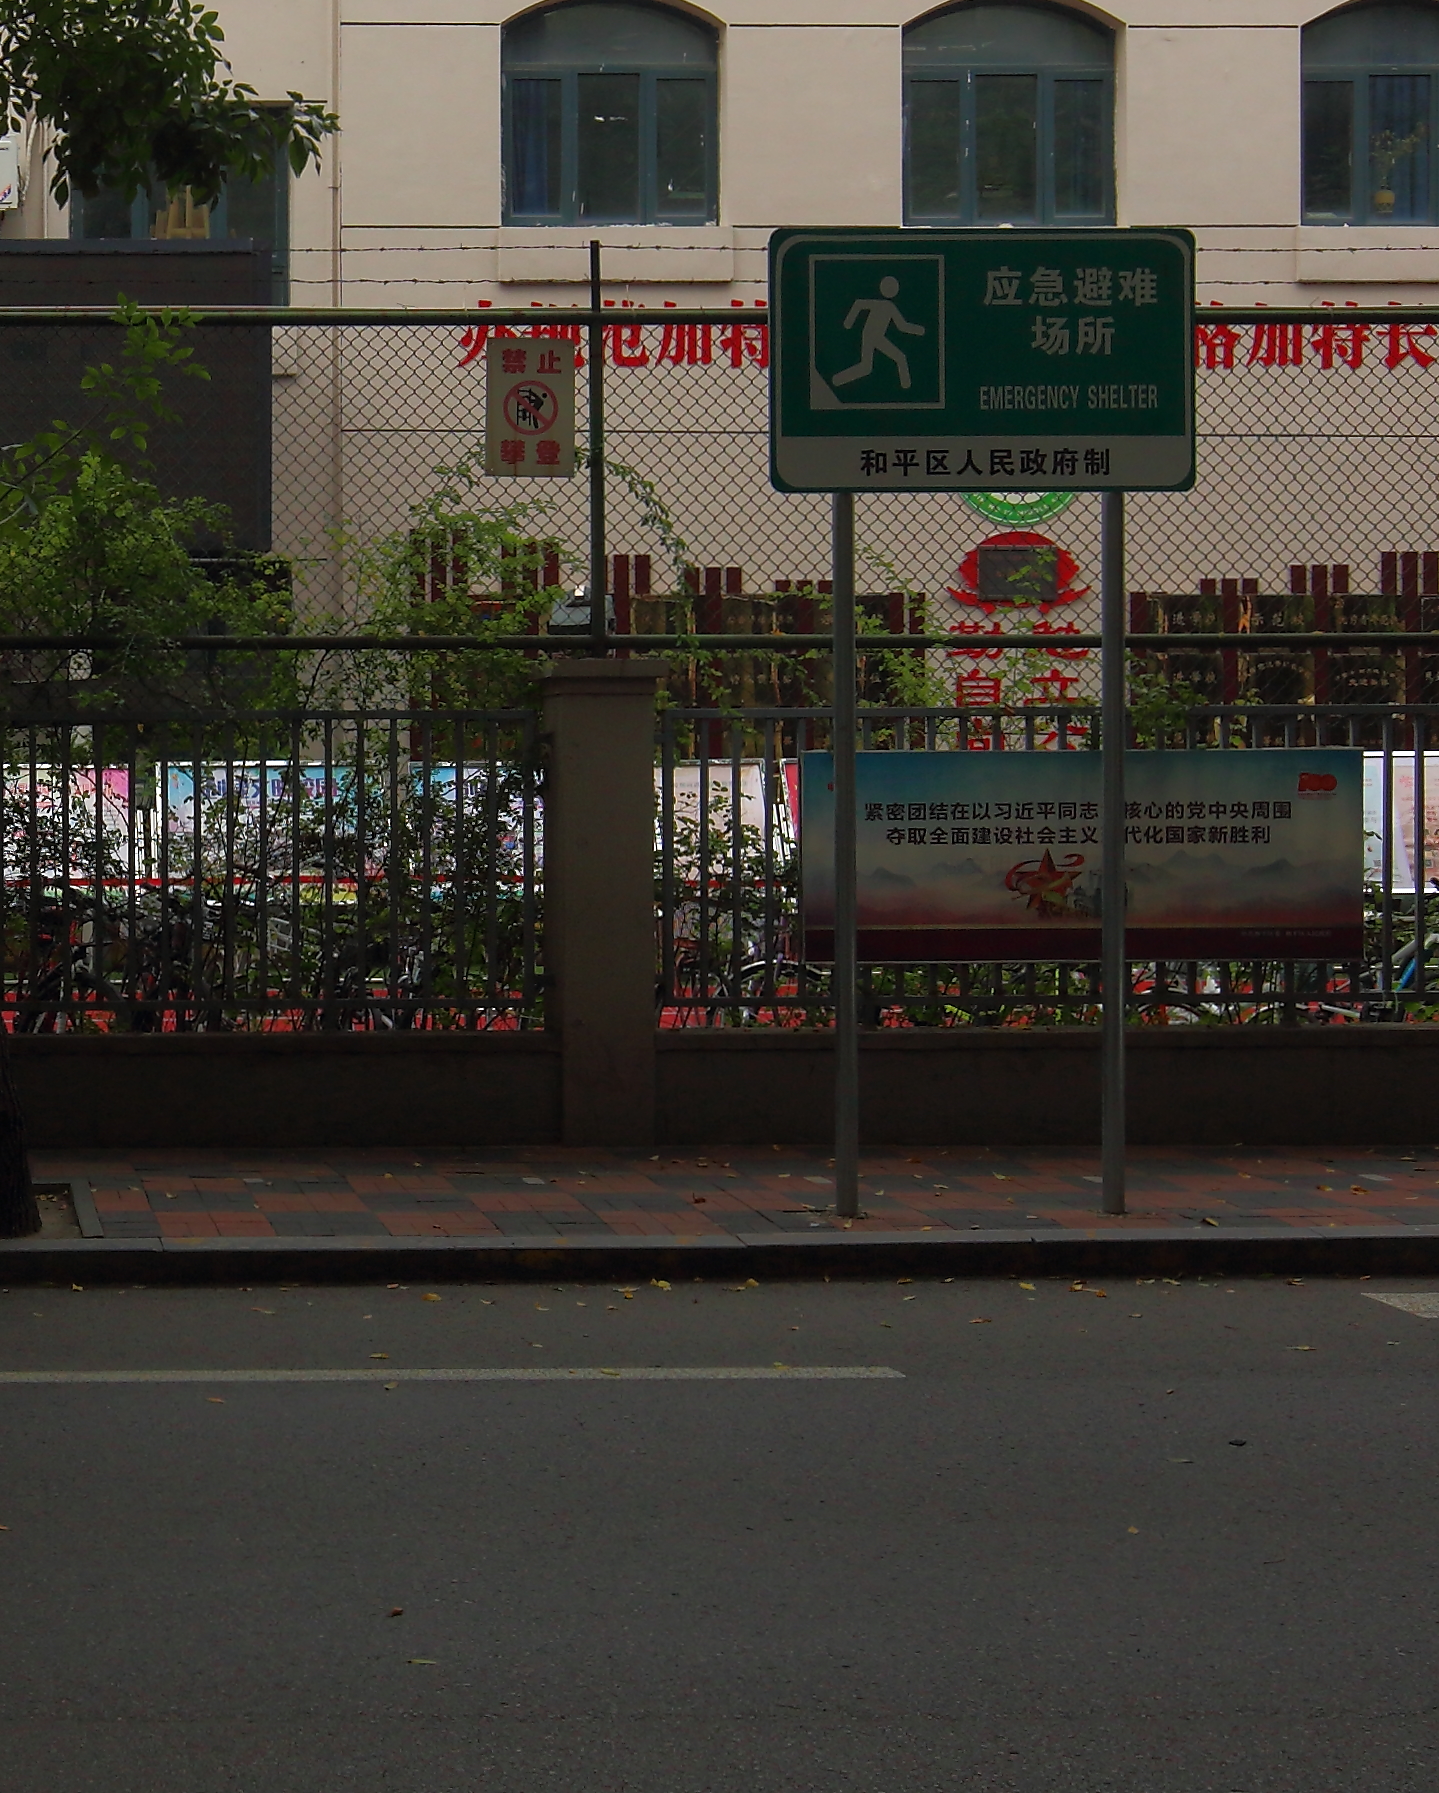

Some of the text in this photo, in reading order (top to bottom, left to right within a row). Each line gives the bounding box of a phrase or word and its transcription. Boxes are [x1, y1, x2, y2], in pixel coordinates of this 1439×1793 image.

[983, 265, 1158, 306] 应急避难
[1031, 315, 1116, 356] 场所
[501, 348, 562, 374] 禁止
[979, 384, 1159, 410] EMERGENCY SHELTER
[500, 439, 561, 466] 攀登
[860, 448, 1111, 477] 和平区人民政府制
[864, 801, 1293, 821] 紧密团结在以习近平同志核心的党中央周围
[886, 825, 1271, 846] 夺取全面建设社会主义代化国家新胜利
